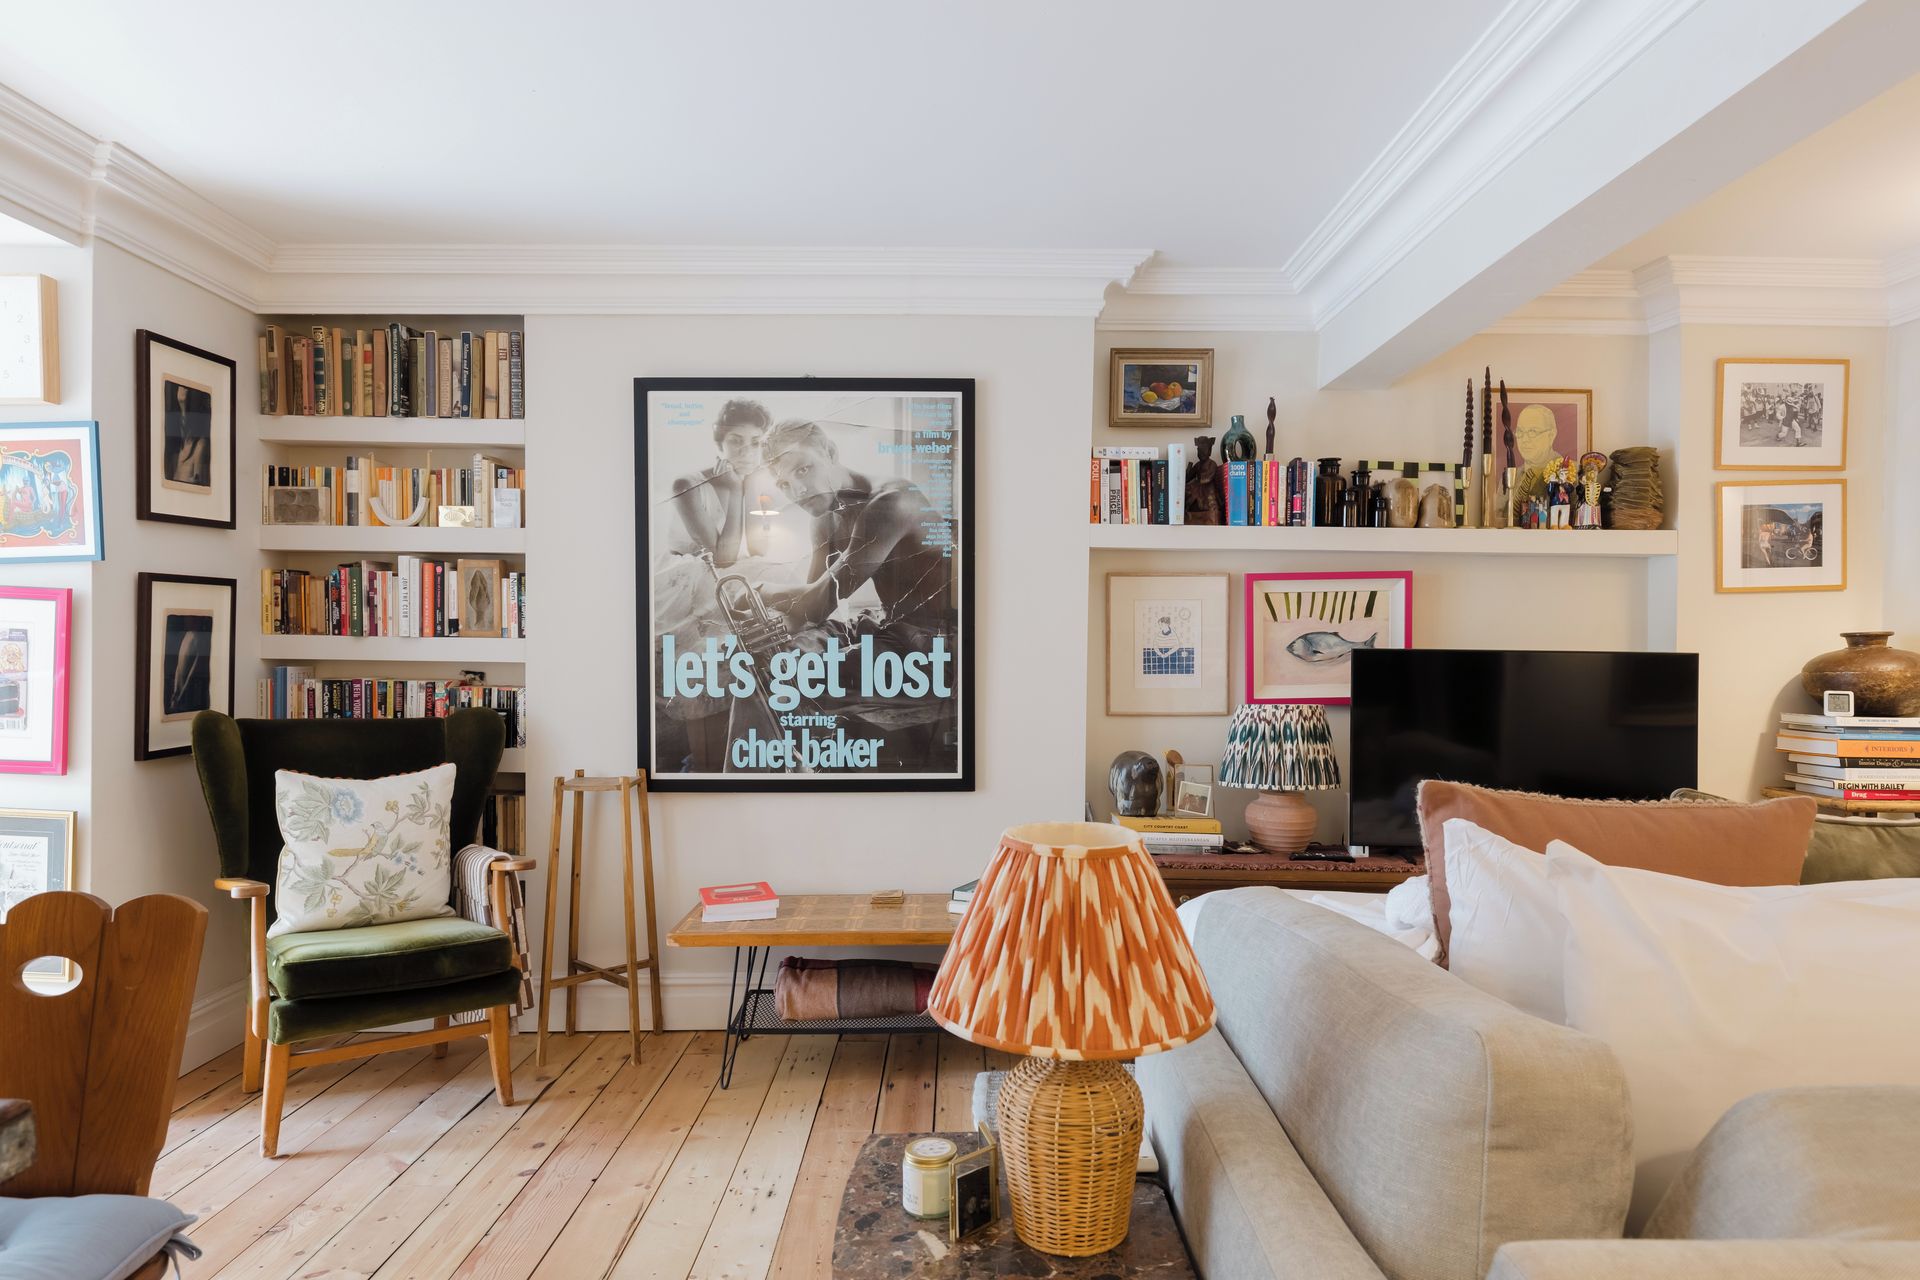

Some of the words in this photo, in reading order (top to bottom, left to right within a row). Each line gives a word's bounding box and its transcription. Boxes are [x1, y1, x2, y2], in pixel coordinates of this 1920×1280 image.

[942, 431, 952, 440] by
[915, 441, 952, 453] weber
[1158, 514, 1164, 522] To
[768, 637, 845, 712] get
[861, 634, 951, 698] lost
[353, 683, 361, 698] NEIL
[353, 699, 361, 719] YOUNG
[780, 712, 837, 728] starring
[731, 729, 797, 768] chet
[802, 729, 884, 768] baker
[1837, 782, 1860, 790] BEGIN
